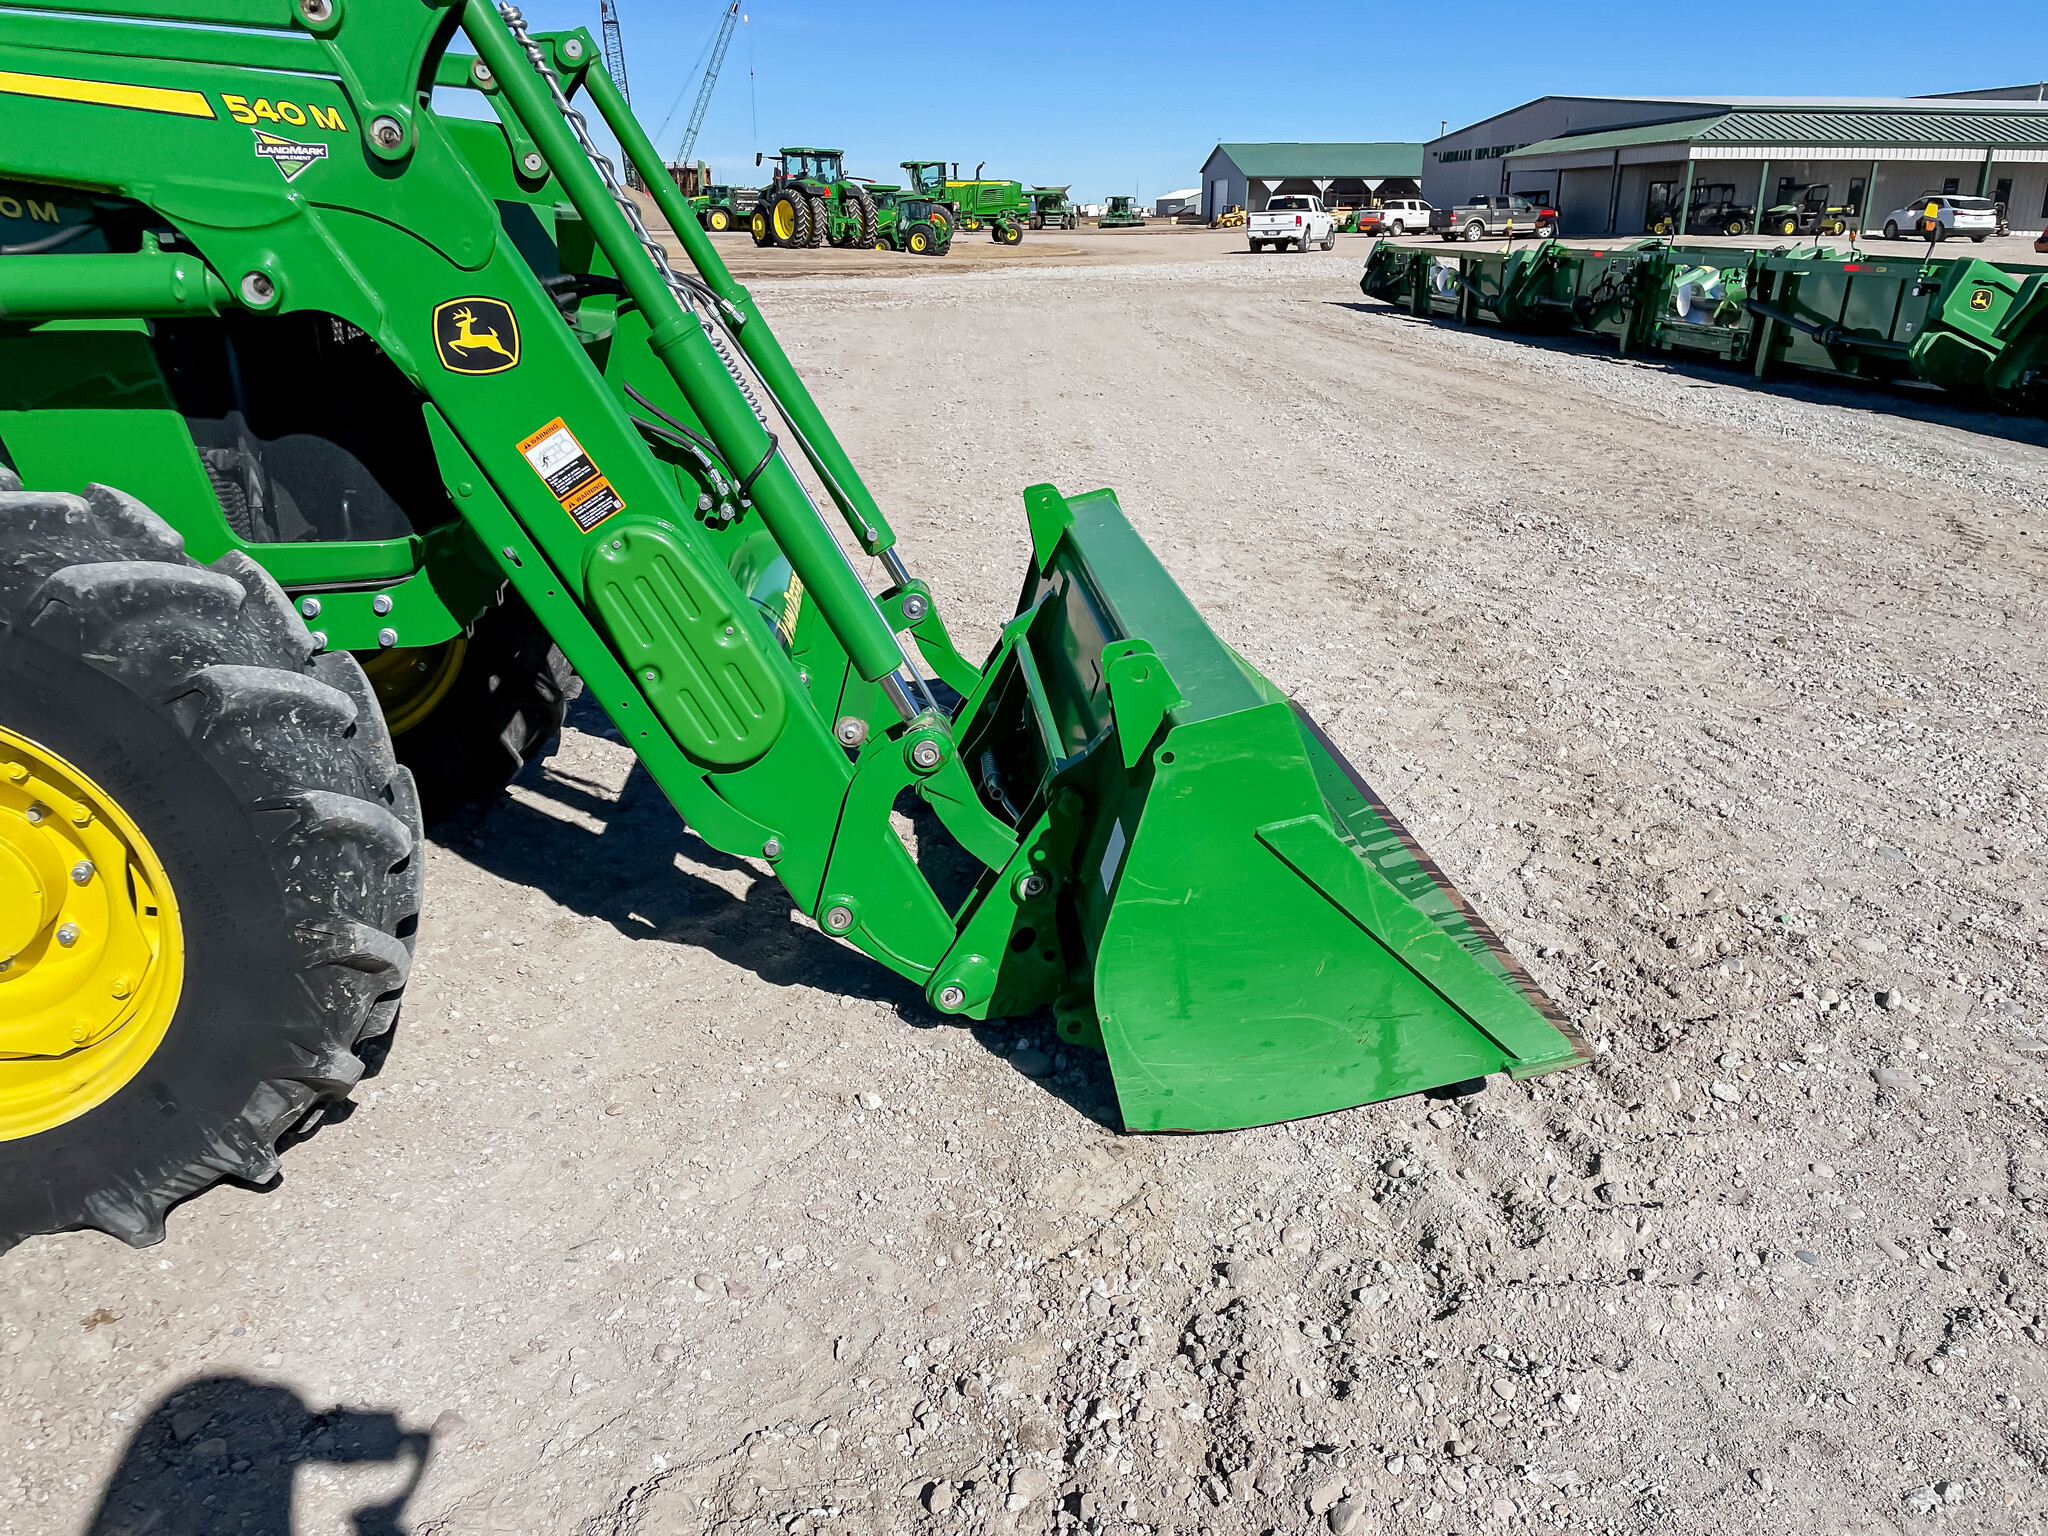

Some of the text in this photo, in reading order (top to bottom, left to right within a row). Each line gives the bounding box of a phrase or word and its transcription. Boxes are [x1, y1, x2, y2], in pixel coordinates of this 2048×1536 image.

[220, 92, 349, 133] 540 M
[530, 423, 559, 446] WARNING
[574, 482, 604, 503] WARNING
